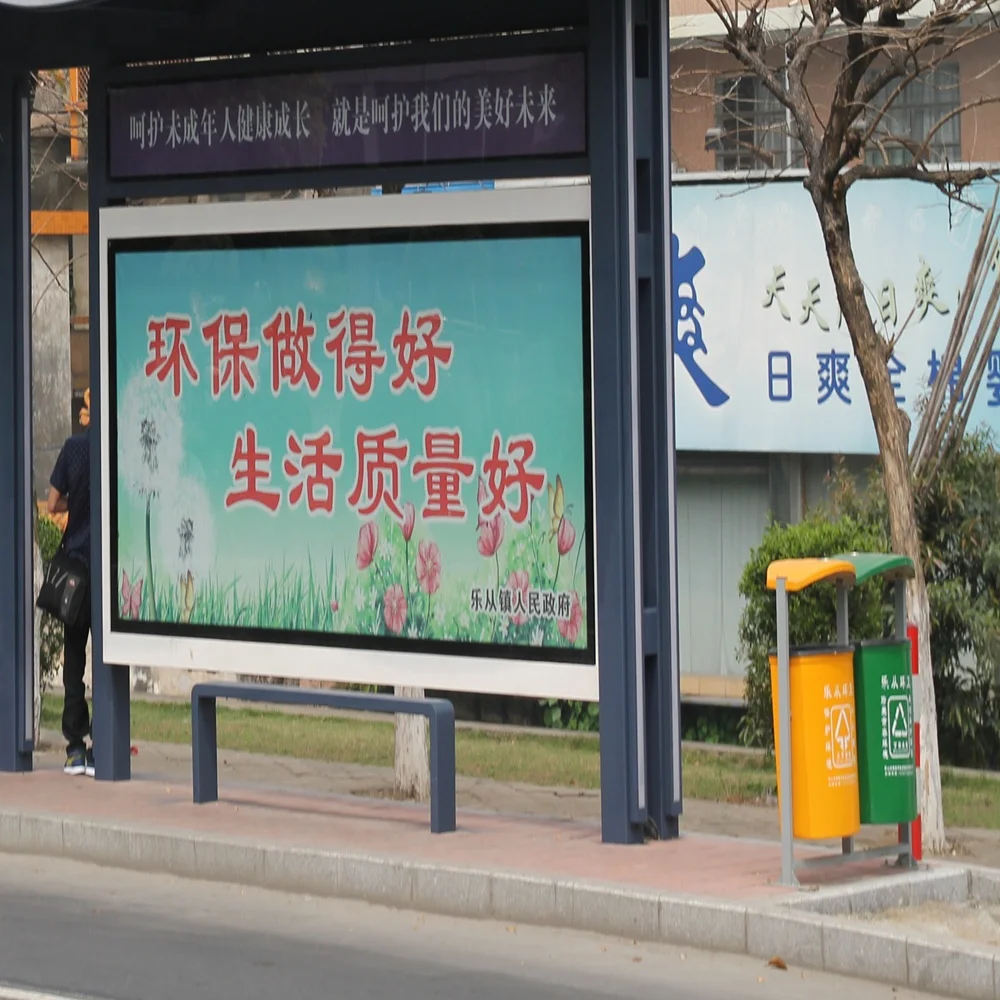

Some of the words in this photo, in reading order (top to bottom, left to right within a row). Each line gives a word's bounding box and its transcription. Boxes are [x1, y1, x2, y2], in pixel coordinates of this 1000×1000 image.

[129, 99, 311, 150] 呵护未成年人健康成长
[331, 83, 557, 136] 就是呵护我们的美好未来
[144, 303, 453, 399] 环保做得好
[224, 425, 545, 524] 生活质量好
[470, 587, 571, 618] 乐从镇人民政府
